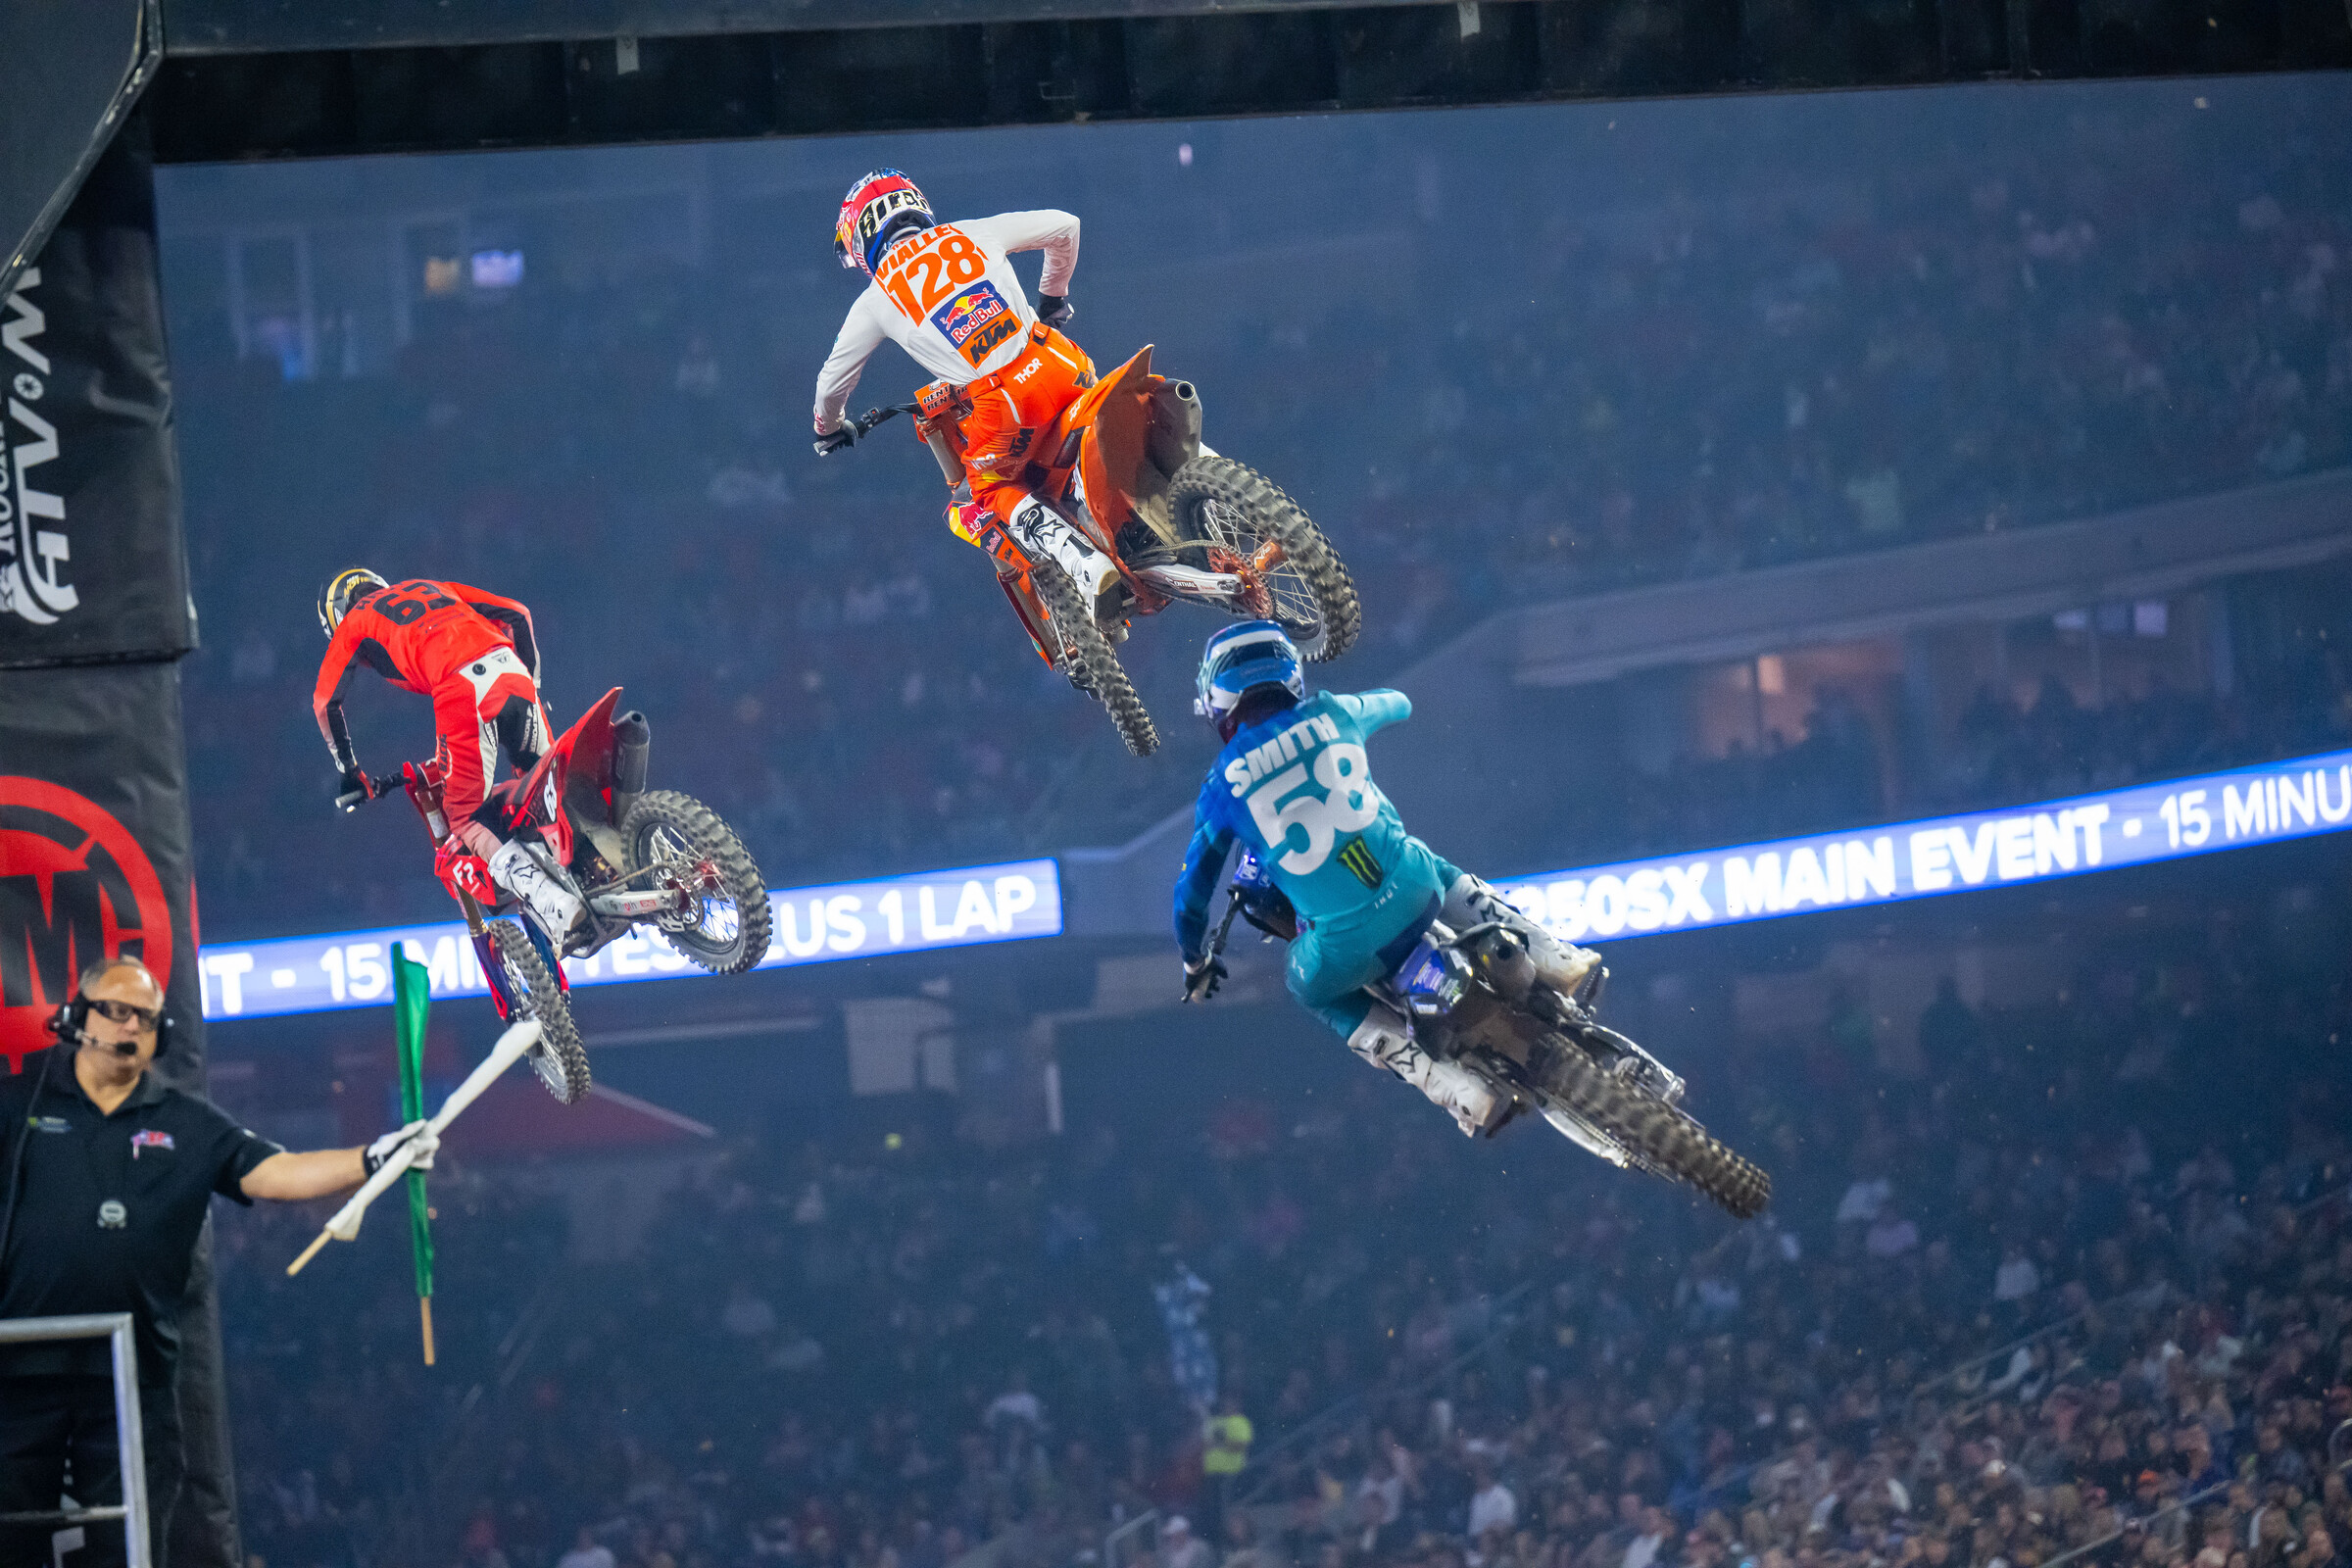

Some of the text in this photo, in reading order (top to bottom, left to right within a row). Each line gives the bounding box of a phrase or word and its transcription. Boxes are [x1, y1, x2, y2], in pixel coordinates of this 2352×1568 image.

[887, 235, 986, 328] 128
[951, 299, 1004, 344] Red Bull
[969, 318, 1018, 365] KTM
[1013, 358, 1044, 384] THOR
[371, 581, 457, 626] 63
[1224, 712, 1341, 799] SMITH
[1246, 742, 1380, 876] 58
[1722, 835, 1897, 918] MAIN
[1909, 803, 2110, 892] EVENT
[2158, 788, 2212, 850] 15
[2221, 762, 2352, 841] MINU
[319, 942, 387, 1002] 15
[877, 889, 903, 946] 1
[919, 874, 1037, 942] LAP
